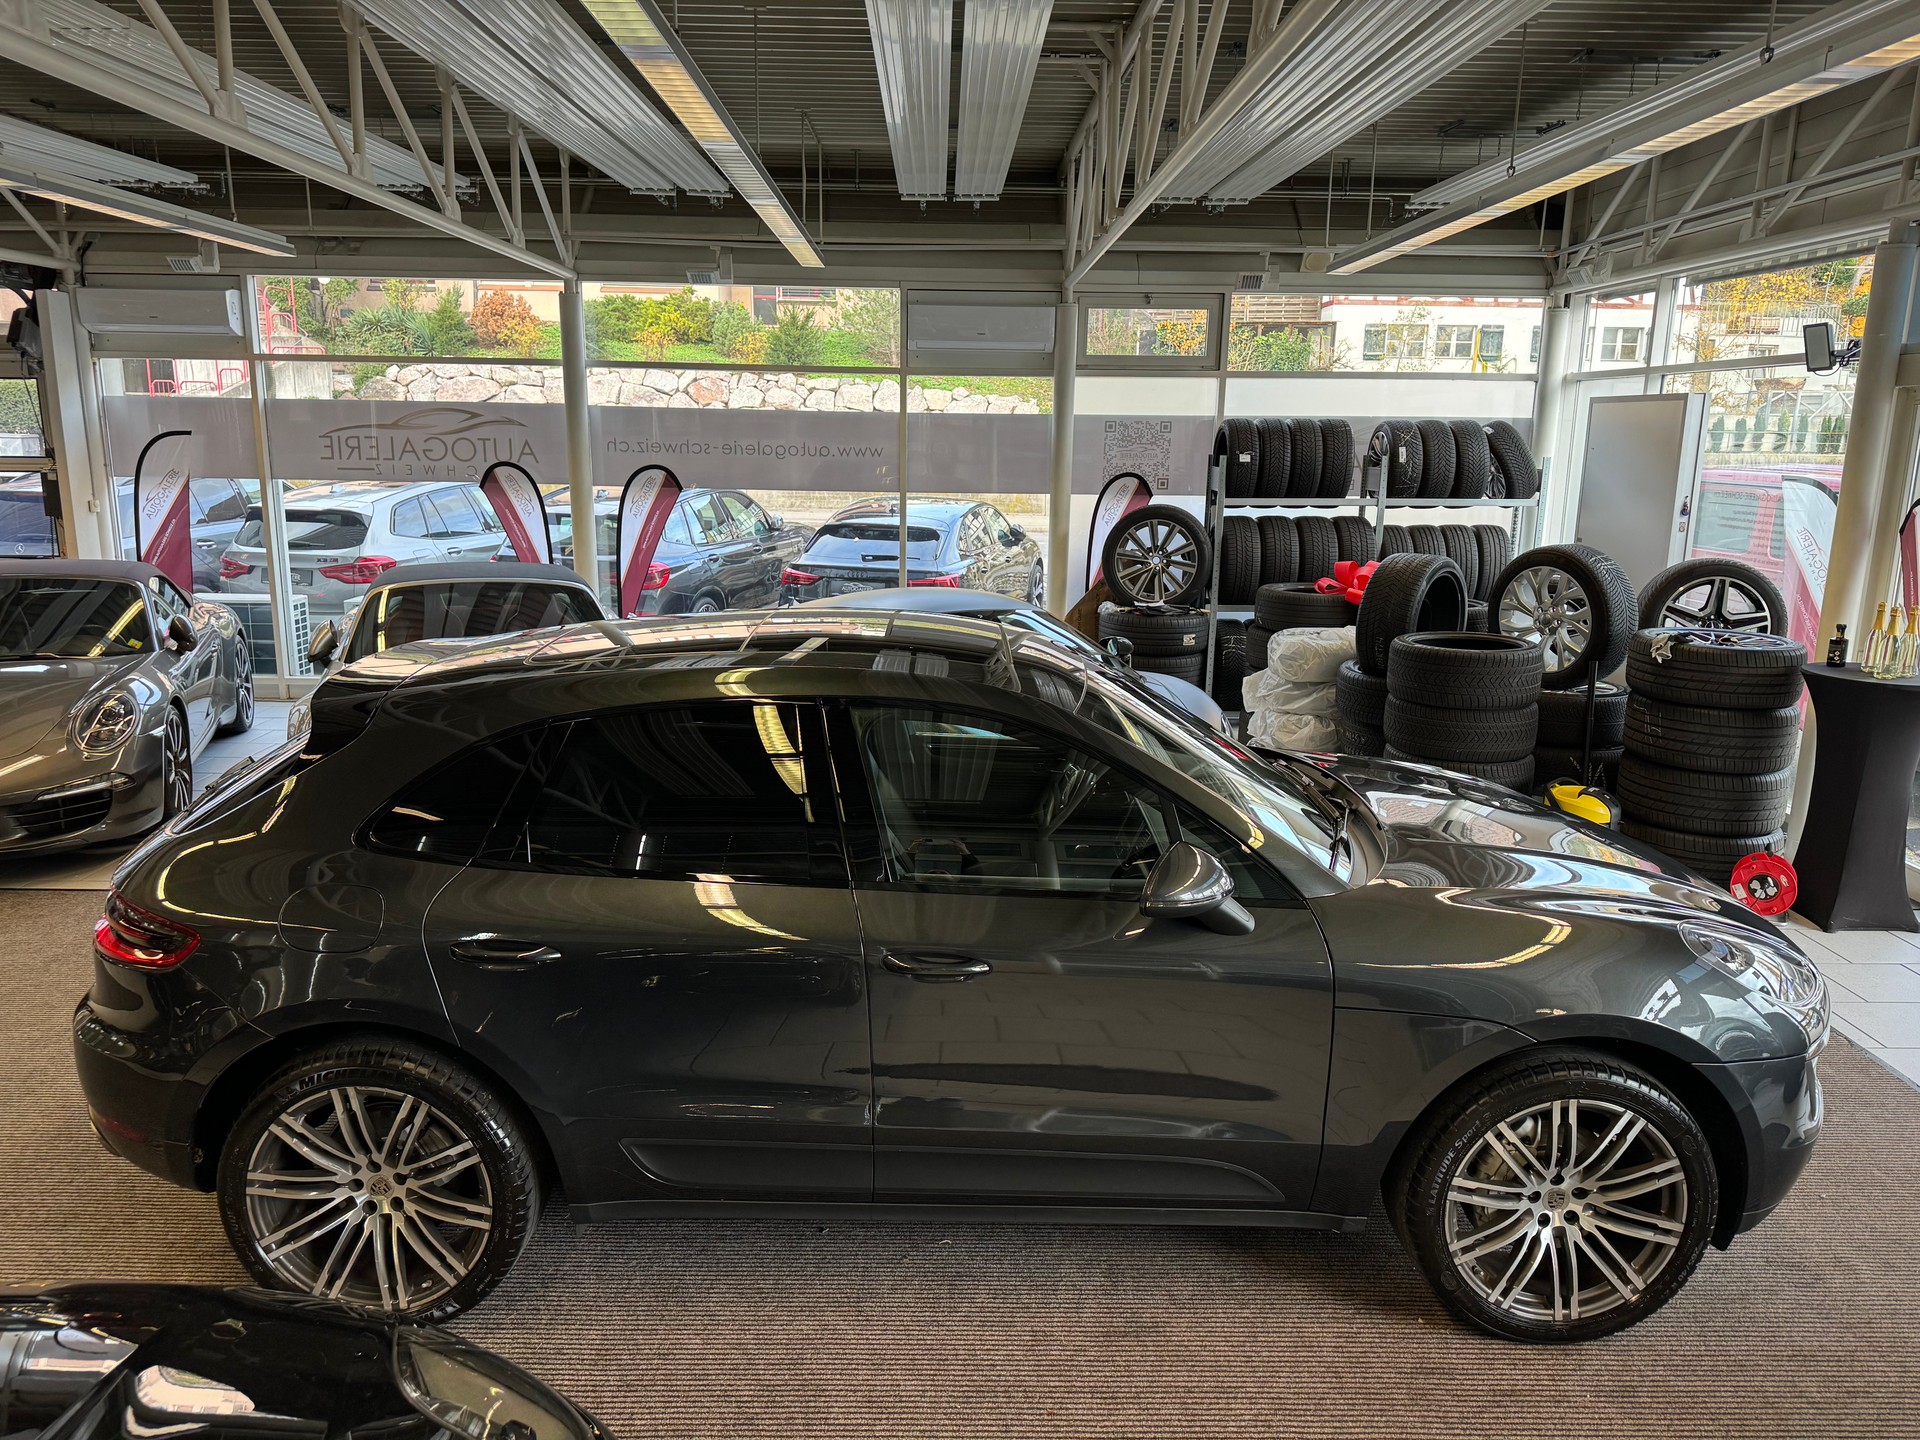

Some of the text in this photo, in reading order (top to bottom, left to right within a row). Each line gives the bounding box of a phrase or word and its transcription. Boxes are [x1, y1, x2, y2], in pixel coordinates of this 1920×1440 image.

[146, 468, 180, 520] AUTOGALERIE
[632, 475, 657, 519] AUTOGALERIE
[1104, 483, 1130, 526] AUTOGALERIE
[1428, 1148, 1457, 1204] LATITUDE
[1454, 1119, 1481, 1149] Sport
